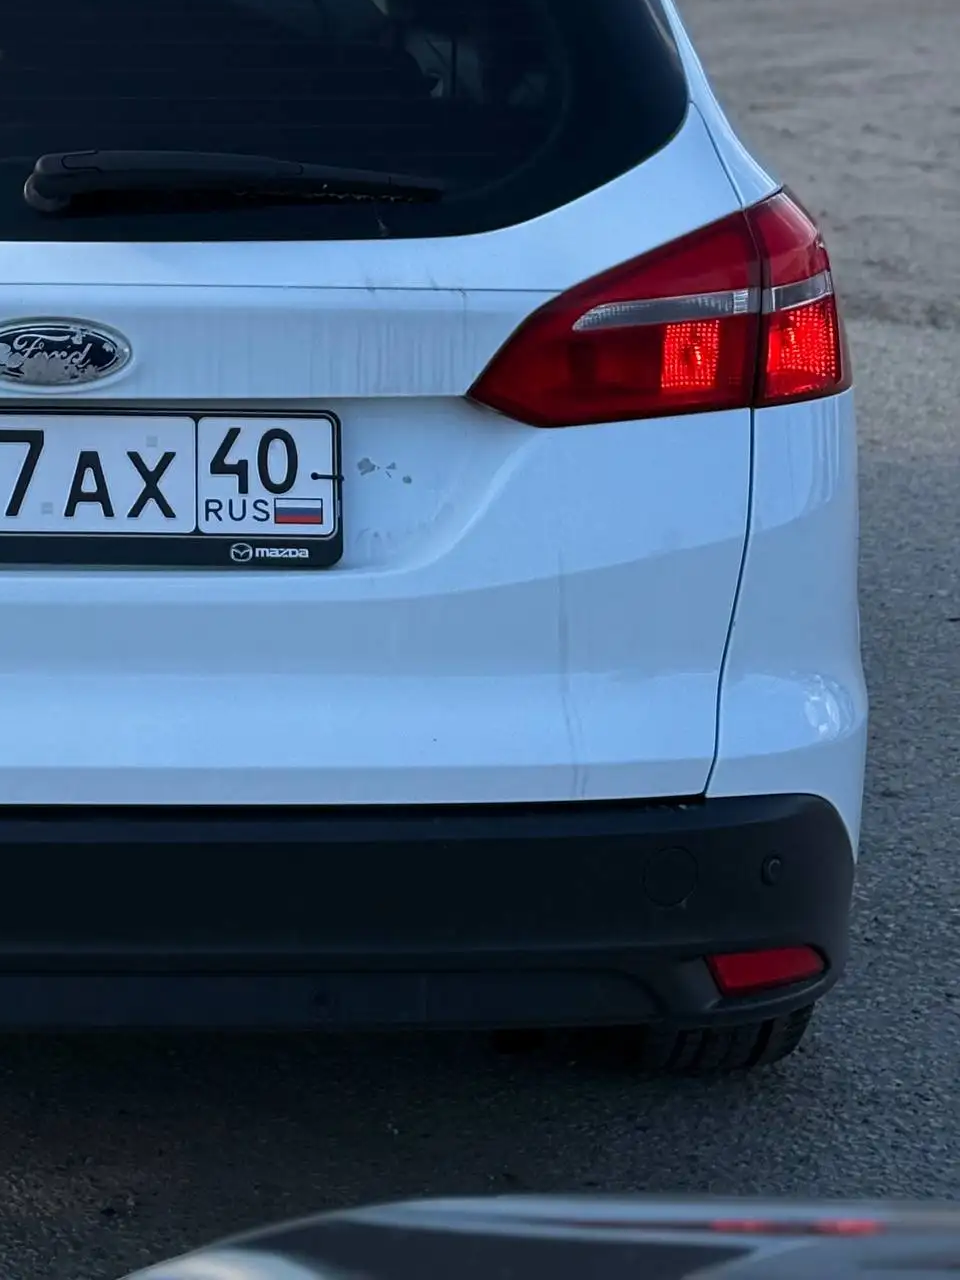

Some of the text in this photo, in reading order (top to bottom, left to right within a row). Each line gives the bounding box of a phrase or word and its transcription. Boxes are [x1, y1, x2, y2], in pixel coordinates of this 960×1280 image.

[209, 427, 298, 495] 40
[204, 498, 271, 522] RUS
[254, 547, 310, 558] mazda
